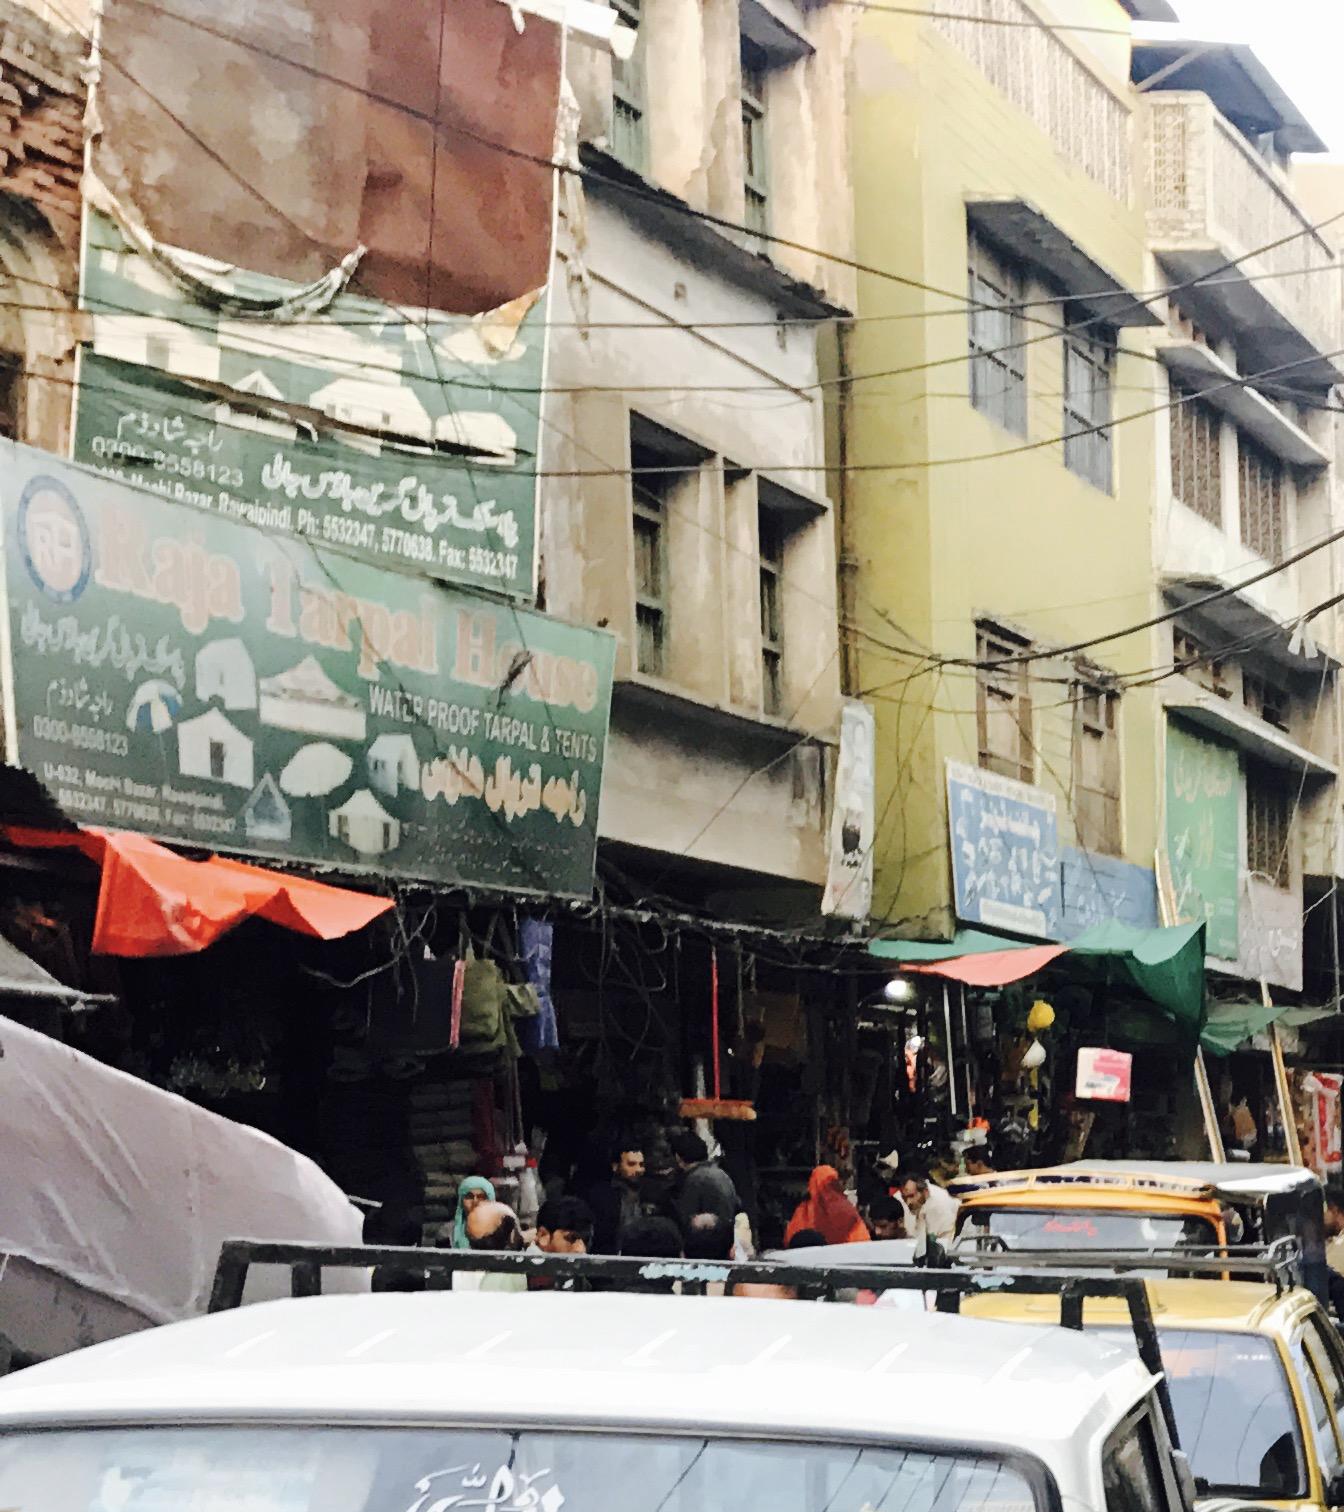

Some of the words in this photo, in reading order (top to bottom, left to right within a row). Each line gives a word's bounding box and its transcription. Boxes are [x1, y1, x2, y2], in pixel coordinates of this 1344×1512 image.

[298, 507, 320, 536] Ph:
[95, 504, 245, 636] Raja
[257, 545, 440, 681] Tarpal
[450, 606, 599, 714] House
[427, 699, 480, 737] PROOF
[483, 711, 538, 750] TARPAL
[540, 725, 550, 753] &
[555, 728, 598, 763] TENTS
